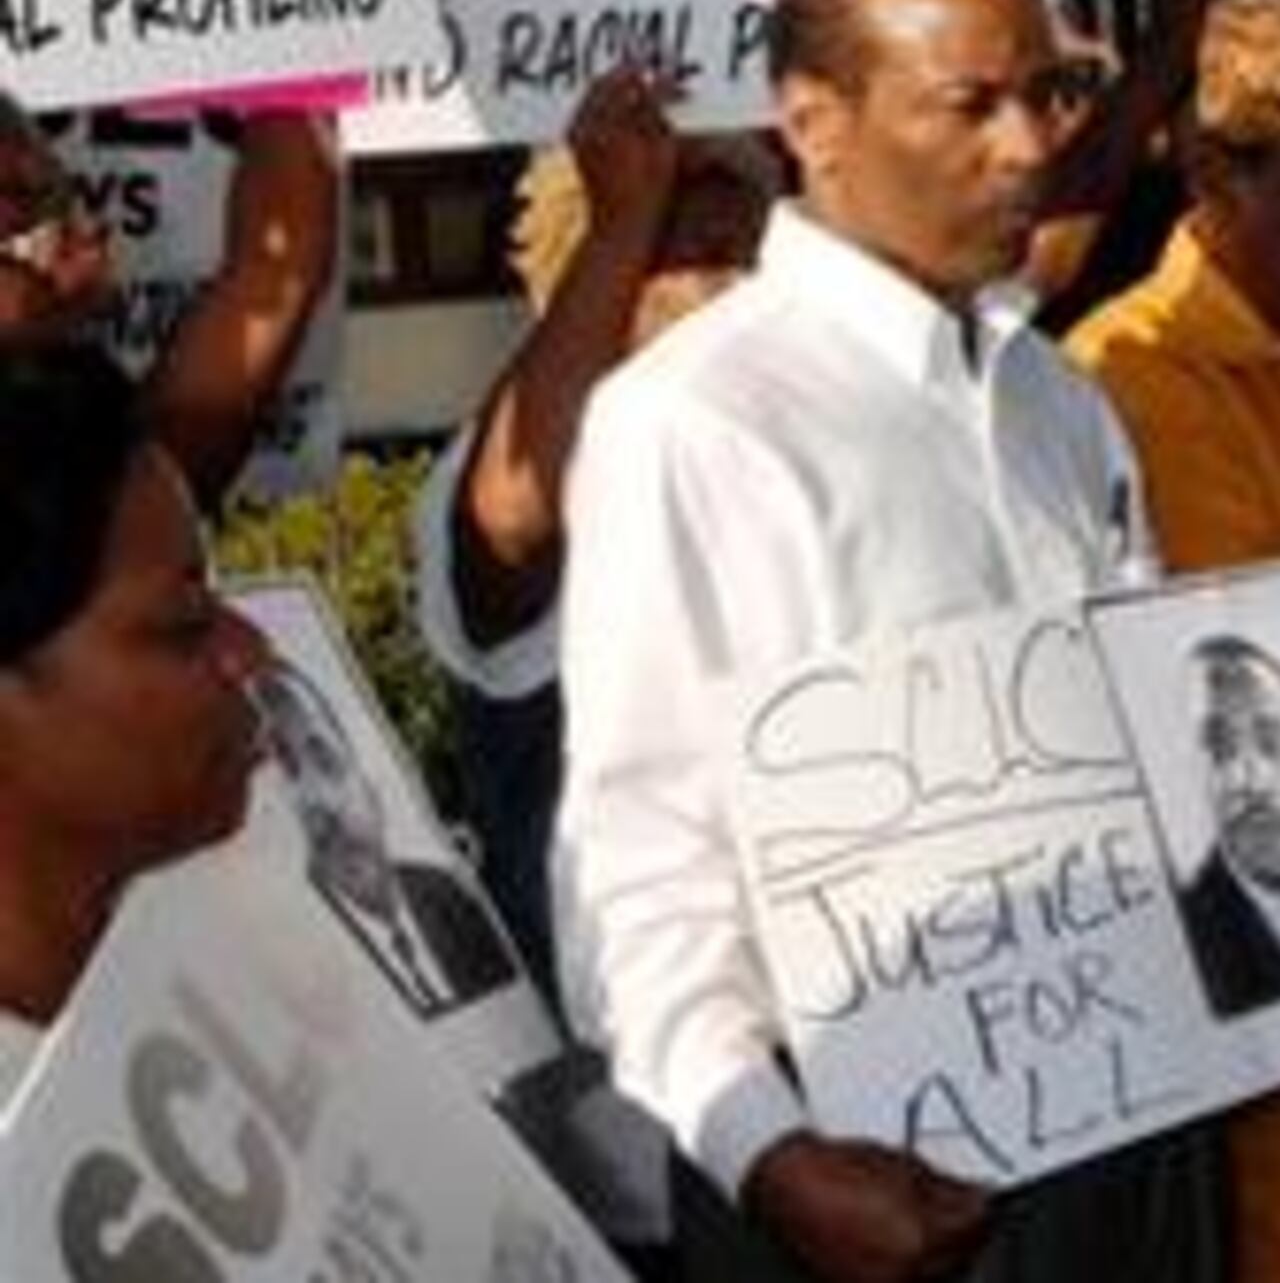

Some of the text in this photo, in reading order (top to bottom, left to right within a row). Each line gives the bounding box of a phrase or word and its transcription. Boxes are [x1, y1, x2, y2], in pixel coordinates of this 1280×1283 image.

[745, 618, 1137, 844] SCLC
[965, 951, 1144, 1074] FOR
[902, 1034, 1197, 1176] ALL
